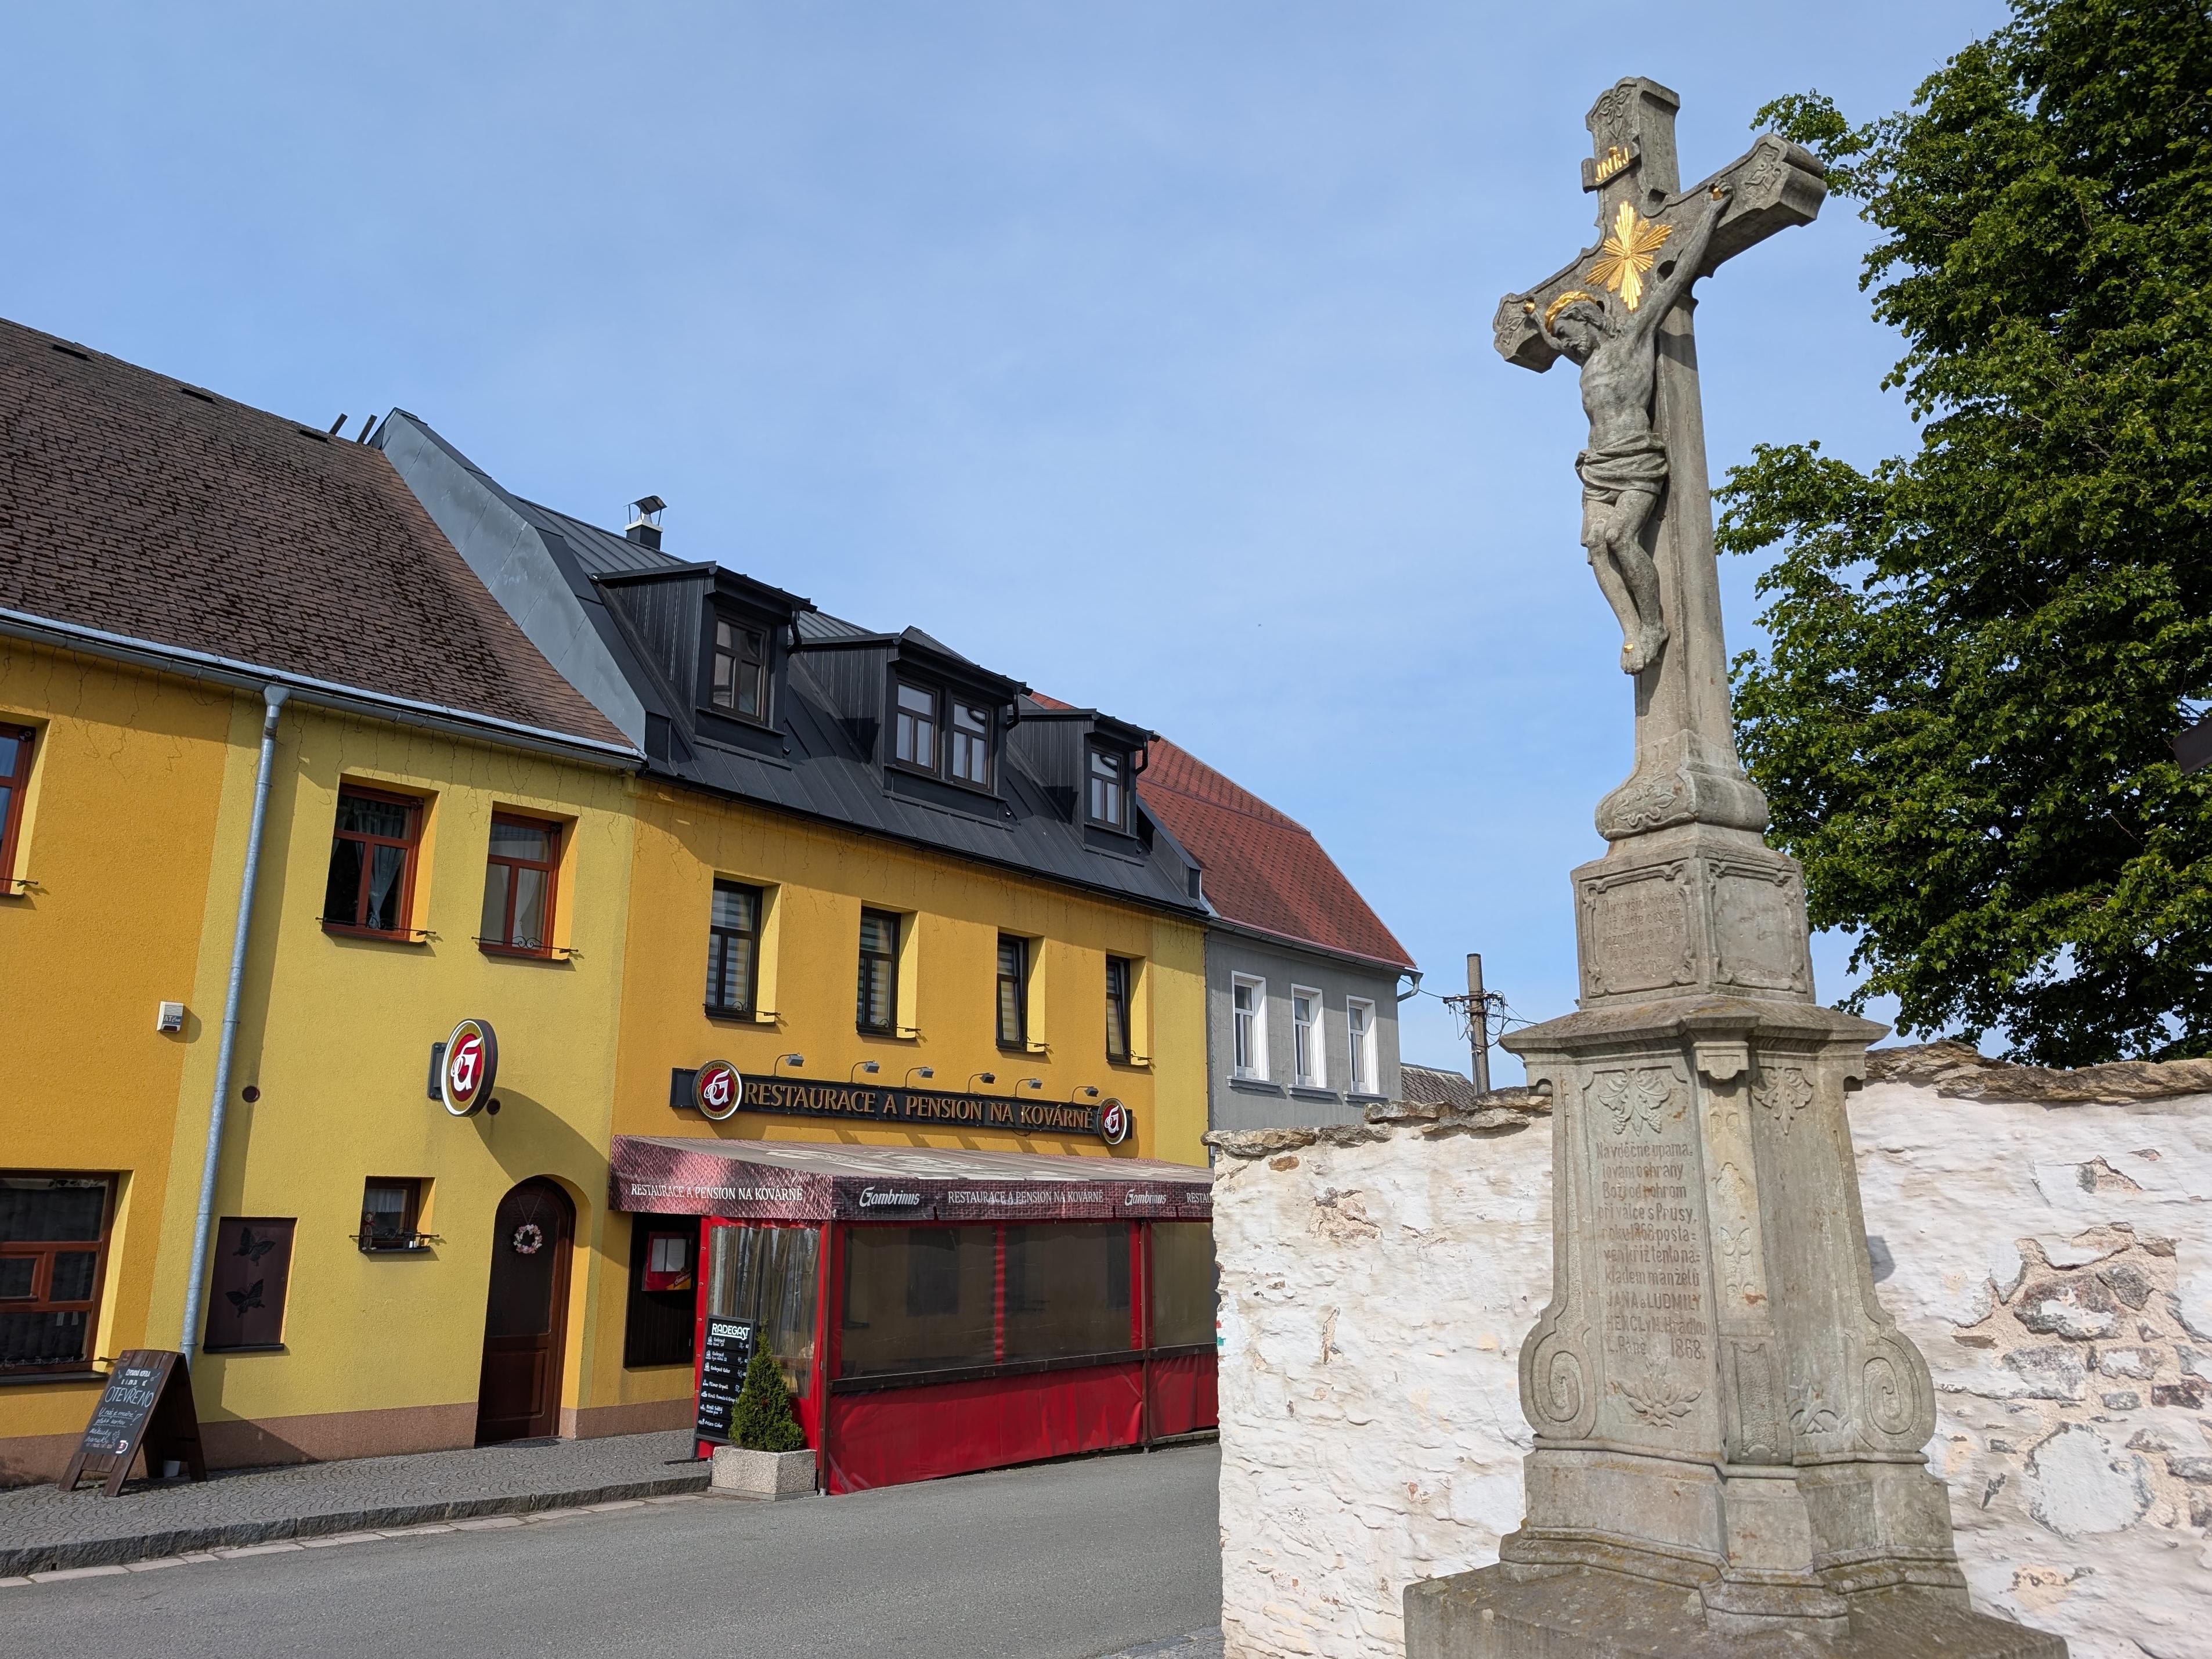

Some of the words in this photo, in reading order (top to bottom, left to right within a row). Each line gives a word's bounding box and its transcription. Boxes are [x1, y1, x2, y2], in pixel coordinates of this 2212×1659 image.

[744, 1082, 875, 1113] RESTAURACE
[882, 1094, 897, 1114] A
[905, 1095, 983, 1121] PENSION
[990, 1103, 1014, 1123] NA
[1021, 1104, 1093, 1128] KOVÁRNĚ
[631, 1183, 684, 1198] RESTAURACE
[687, 1186, 694, 1198] A
[695, 1186, 735, 1199] PENSION
[738, 1188, 753, 1200] NA
[755, 1185, 803, 1201] KOVÁRNĚ
[859, 1185, 920, 1207] Gambrinus
[948, 1191, 1005, 1203] RESTAURACE
[1008, 1191, 1014, 1203] A
[1016, 1191, 1052, 1203] PENSION
[1054, 1191, 1065, 1203] NA
[1068, 1189, 1103, 1203] KOVÁRNĚ
[1125, 1188, 1167, 1206] Gambrinus
[1648, 1207, 1654, 1220] s
[1651, 1245, 1679, 1263] tento
[1606, 1291, 1638, 1309] JANA
[1647, 1293, 1701, 1311] LUDMILY
[712, 1323, 750, 1340] RADEGAST
[105, 1386, 154, 1408] OTEVŘENO
